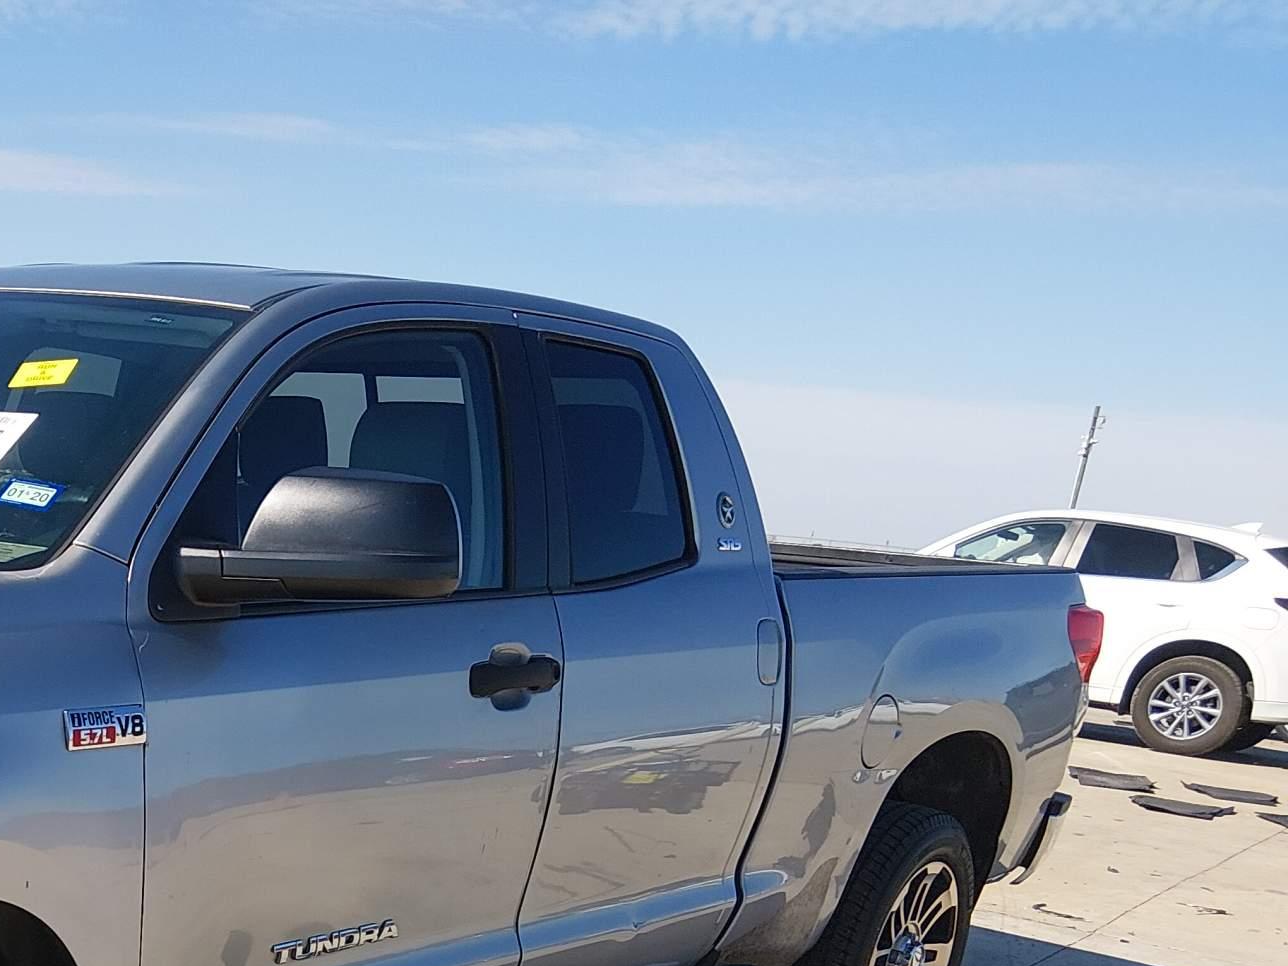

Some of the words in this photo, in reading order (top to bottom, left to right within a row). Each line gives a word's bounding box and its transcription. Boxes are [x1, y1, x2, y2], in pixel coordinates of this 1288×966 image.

[7, 487, 25, 498] 01
[29, 491, 50, 502] 20
[116, 714, 145, 737] V8
[80, 729, 112, 745] 5.7L
[270, 919, 399, 964] TUNDRA
